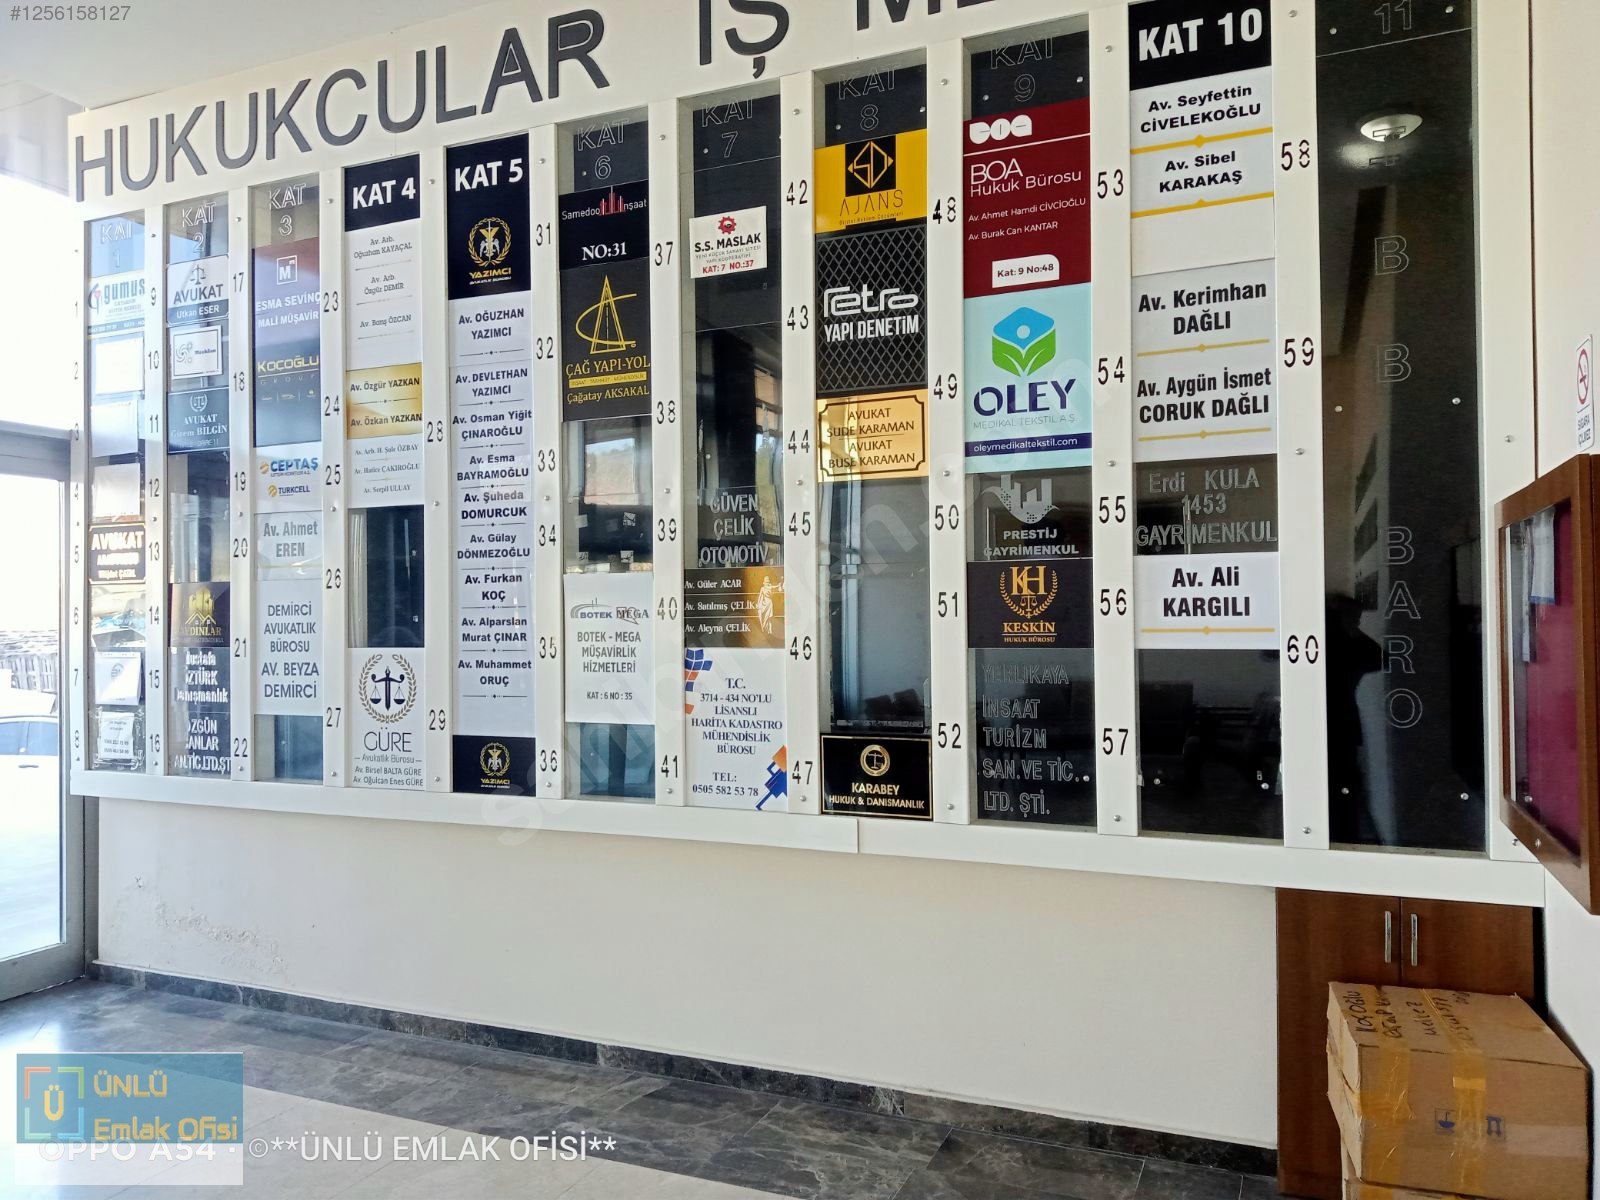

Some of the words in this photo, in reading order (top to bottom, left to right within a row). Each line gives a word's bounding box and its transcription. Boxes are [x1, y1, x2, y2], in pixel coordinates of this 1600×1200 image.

[1374, 0, 1412, 34] 11
[1138, 18, 1204, 62] KAT
[1217, 7, 1263, 46] 10
[1014, 74, 1036, 102] 9
[75, 8, 611, 203] HUKUKCULAR
[1148, 100, 1172, 113] Av.
[1177, 86, 1252, 107] Seyfettin
[860, 104, 879, 131] 8
[1141, 103, 1261, 133] CİVELEKOĞLU
[1165, 160, 1189, 172] Av.
[1194, 151, 1235, 167] Sibel
[1281, 139, 1310, 171] 58
[455, 160, 502, 192] KAT
[509, 157, 523, 183] 5
[971, 158, 1023, 185] BOA
[971, 178, 1020, 198] Hukuk
[1026, 170, 1082, 189] Bürosu
[1159, 170, 1243, 193] KARAKAŞ
[353, 180, 396, 210] KAT
[401, 177, 416, 200] 4
[181, 202, 216, 227] KAT
[536, 222, 551, 246] 31
[968, 232, 980, 241] Av.
[981, 229, 1004, 239] Burak
[1006, 226, 1022, 235] Can
[1024, 221, 1058, 233] KANTAR
[193, 232, 205, 253] 2
[582, 242, 627, 261] NO:31
[695, 241, 713, 252] S.S.
[717, 233, 761, 249] MASLAK
[174, 284, 224, 304] AVUKAT
[324, 291, 339, 312] 23
[1138, 294, 1166, 313] Av.
[1173, 283, 1267, 308] Kerimhan
[176, 308, 197, 319] Utkan
[199, 305, 220, 315] ESER
[255, 297, 282, 313] ESMA
[459, 315, 472, 324] Av.
[475, 308, 524, 323] OĞUZHAN
[1173, 309, 1231, 335] DAĞLI
[471, 327, 511, 340] YAZIMCI
[824, 321, 854, 342] YAPI
[858, 315, 919, 339] DENETİM
[536, 336, 554, 360] 32
[1284, 337, 1314, 368] 59
[456, 374, 470, 384] Av.
[472, 368, 528, 382] DEVLETHAN
[566, 359, 591, 378] ÇAĞ
[593, 355, 650, 373] YAPI-YOL
[350, 382, 362, 392] Av.
[364, 379, 386, 392] Özgür
[388, 378, 420, 390] YAZKAN
[472, 385, 511, 397] YAZIMCI
[1137, 379, 1161, 398] Av.
[1166, 374, 1217, 398] Aygün
[1223, 367, 1271, 389] İsmet
[567, 388, 602, 404] Çağatay
[605, 385, 650, 399] AKSAKAL
[974, 378, 1076, 417] OLEY
[848, 408, 891, 421] AVUKAT
[1139, 400, 1206, 424] CORUK
[1212, 392, 1269, 417] DAĞLI
[184, 413, 217, 424] AVUKAT
[350, 418, 362, 428] Av.
[364, 415, 389, 426] Özkan
[390, 413, 422, 424] YAZKAN
[462, 426, 523, 441] ÇINAROĞLU
[827, 426, 856, 437] SUDE
[859, 421, 915, 435] KARAMAN
[849, 439, 893, 452] AVUKAT
[974, 437, 1078, 453] oleymedikaltekstil.com
[270, 457, 318, 473] CEPTAŞ
[538, 449, 556, 472] 33
[829, 456, 857, 468] BUSE
[859, 453, 915, 467] KARAMAN
[325, 464, 341, 484] 25
[457, 467, 529, 481] BAYRAMOĞLU
[1150, 471, 1185, 493] Erdi
[1204, 467, 1260, 491] KULA
[149, 478, 160, 497] 12
[461, 506, 527, 520] DOMURCUK
[1182, 493, 1227, 515] 1453
[470, 535, 484, 543] Av.
[488, 533, 516, 544] Gülay
[539, 524, 556, 547] 34
[658, 518, 677, 542] 39
[1004, 527, 1058, 540] PRESTİJ
[92, 531, 143, 550] AVUKAT
[276, 542, 305, 558] EREN
[984, 543, 1079, 557] GAYRİMENKUL
[457, 547, 530, 559] DÖNMEZOĞLU
[700, 542, 769, 564] OTOMOTİV
[326, 568, 342, 589] 26
[685, 580, 695, 588] Av.
[698, 580, 717, 588] Güler
[720, 579, 741, 588] ACAR
[149, 606, 160, 624] 14
[268, 600, 312, 616] DEMİRCİ
[616, 607, 649, 619] MEGA
[658, 596, 678, 620] 40
[1163, 596, 1250, 617] KARGILI
[264, 622, 316, 634] AVUKATLIK
[685, 624, 695, 632] Av.
[698, 624, 723, 634] Aleyna
[726, 623, 750, 633] ÇELİK
[1003, 620, 1056, 633] KESKİN
[1381, 525, 1423, 729] BARO
[270, 638, 310, 653] BÜROSU
[462, 633, 491, 642] Murat
[494, 632, 527, 643] ÇINAR
[577, 632, 606, 642] BOTEK
[615, 631, 641, 642] MEGA
[1029, 635, 1056, 643] BÜROSU
[539, 636, 557, 659] 35
[582, 646, 636, 659] MÜŞAVİRLİK
[790, 636, 812, 660] 46
[1287, 635, 1319, 664] 60
[262, 662, 279, 676] AV.
[284, 662, 319, 676] BEYZA
[583, 660, 636, 673] HİZMETLERİ
[264, 682, 316, 698] DEMİRCİ
[480, 676, 509, 686] ORUÇ
[725, 678, 746, 689] T.C.
[326, 707, 342, 728] 27
[715, 704, 757, 716] LİSANSLI
[429, 709, 446, 731] 29
[692, 717, 727, 728] HARİTA
[729, 719, 782, 730] KADASTRO
[364, 727, 412, 752] GÜRE
[703, 730, 771, 743] MÜHENDİSLİK
[717, 743, 755, 754] BÜROSU
[539, 749, 558, 772] 36
[661, 754, 678, 778] 41
[792, 761, 813, 785] 47
[851, 782, 900, 795] KARABEY
